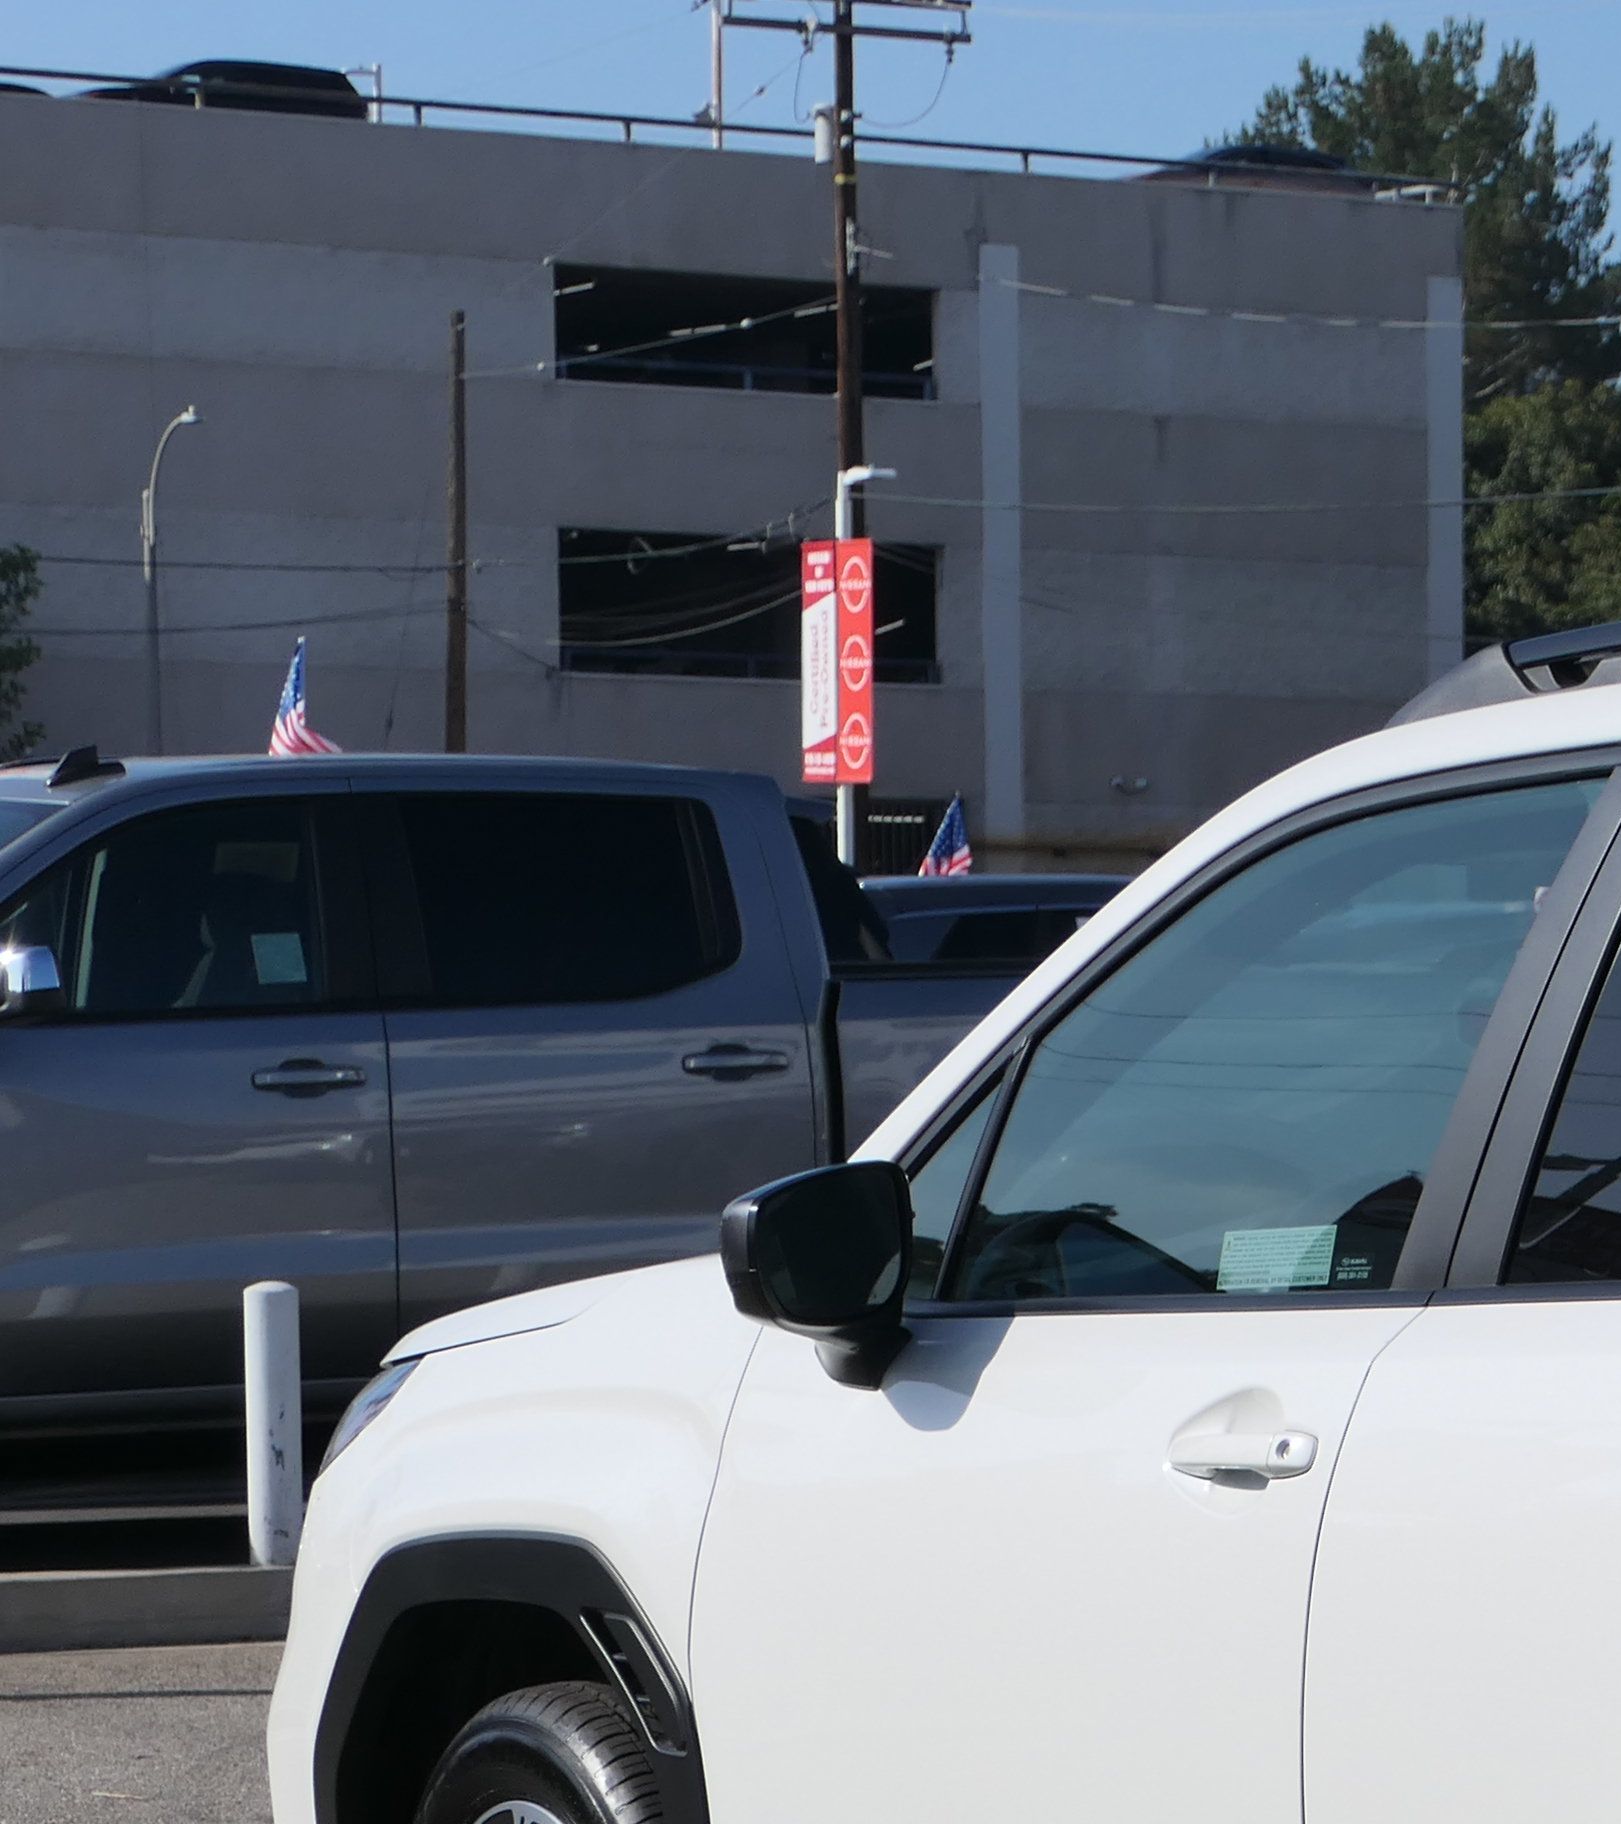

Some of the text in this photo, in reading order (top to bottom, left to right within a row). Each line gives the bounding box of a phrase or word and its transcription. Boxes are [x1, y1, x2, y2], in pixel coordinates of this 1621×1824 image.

[839, 579, 872, 591] NISSAN
[839, 657, 872, 669] NISSAN
[839, 735, 872, 747] NISSAN
